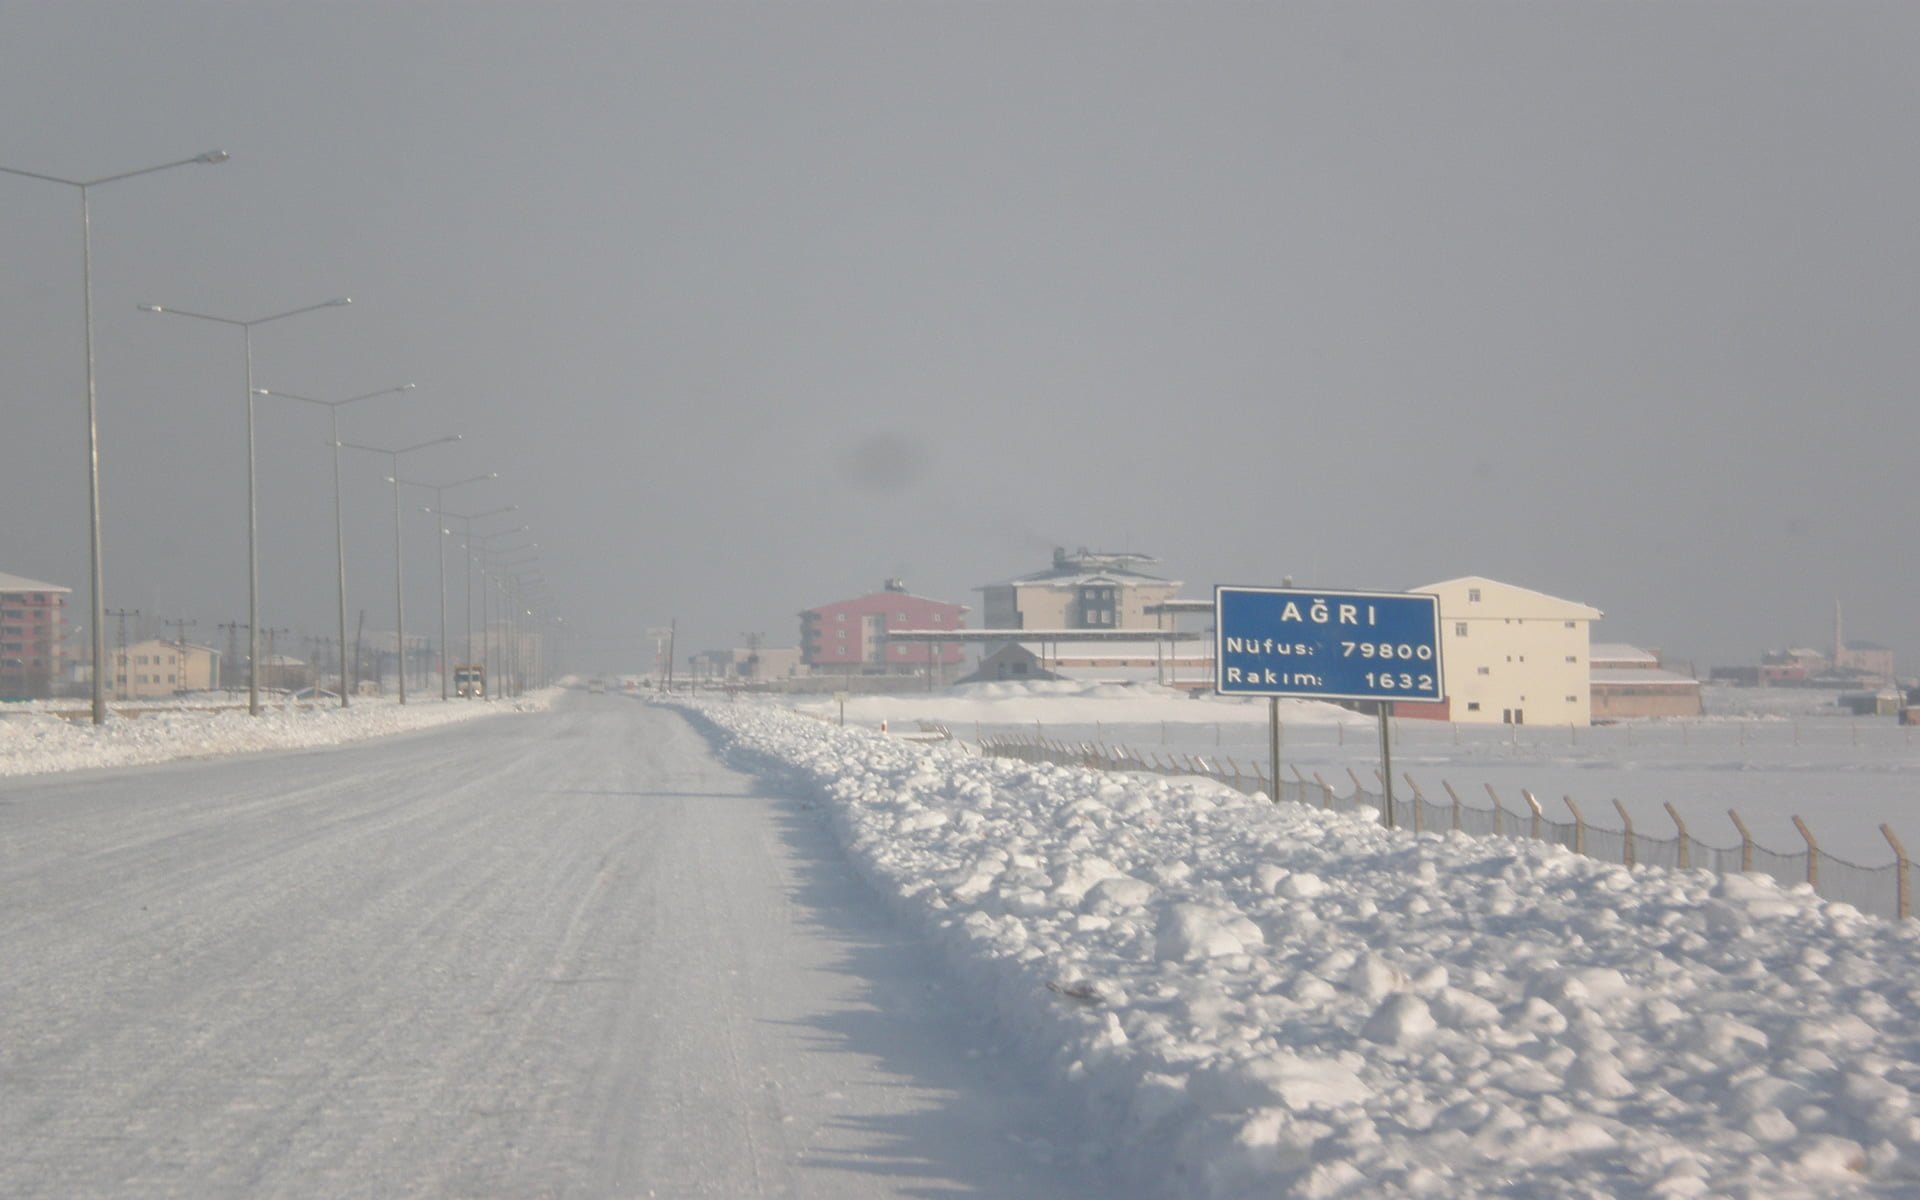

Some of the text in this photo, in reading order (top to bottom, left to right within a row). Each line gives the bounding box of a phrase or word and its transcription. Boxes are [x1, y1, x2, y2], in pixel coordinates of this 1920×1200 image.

[1281, 598, 1376, 625] AĞRI
[1340, 641, 1432, 660] 79800
[1227, 667, 1433, 690] Rakım: 1632
